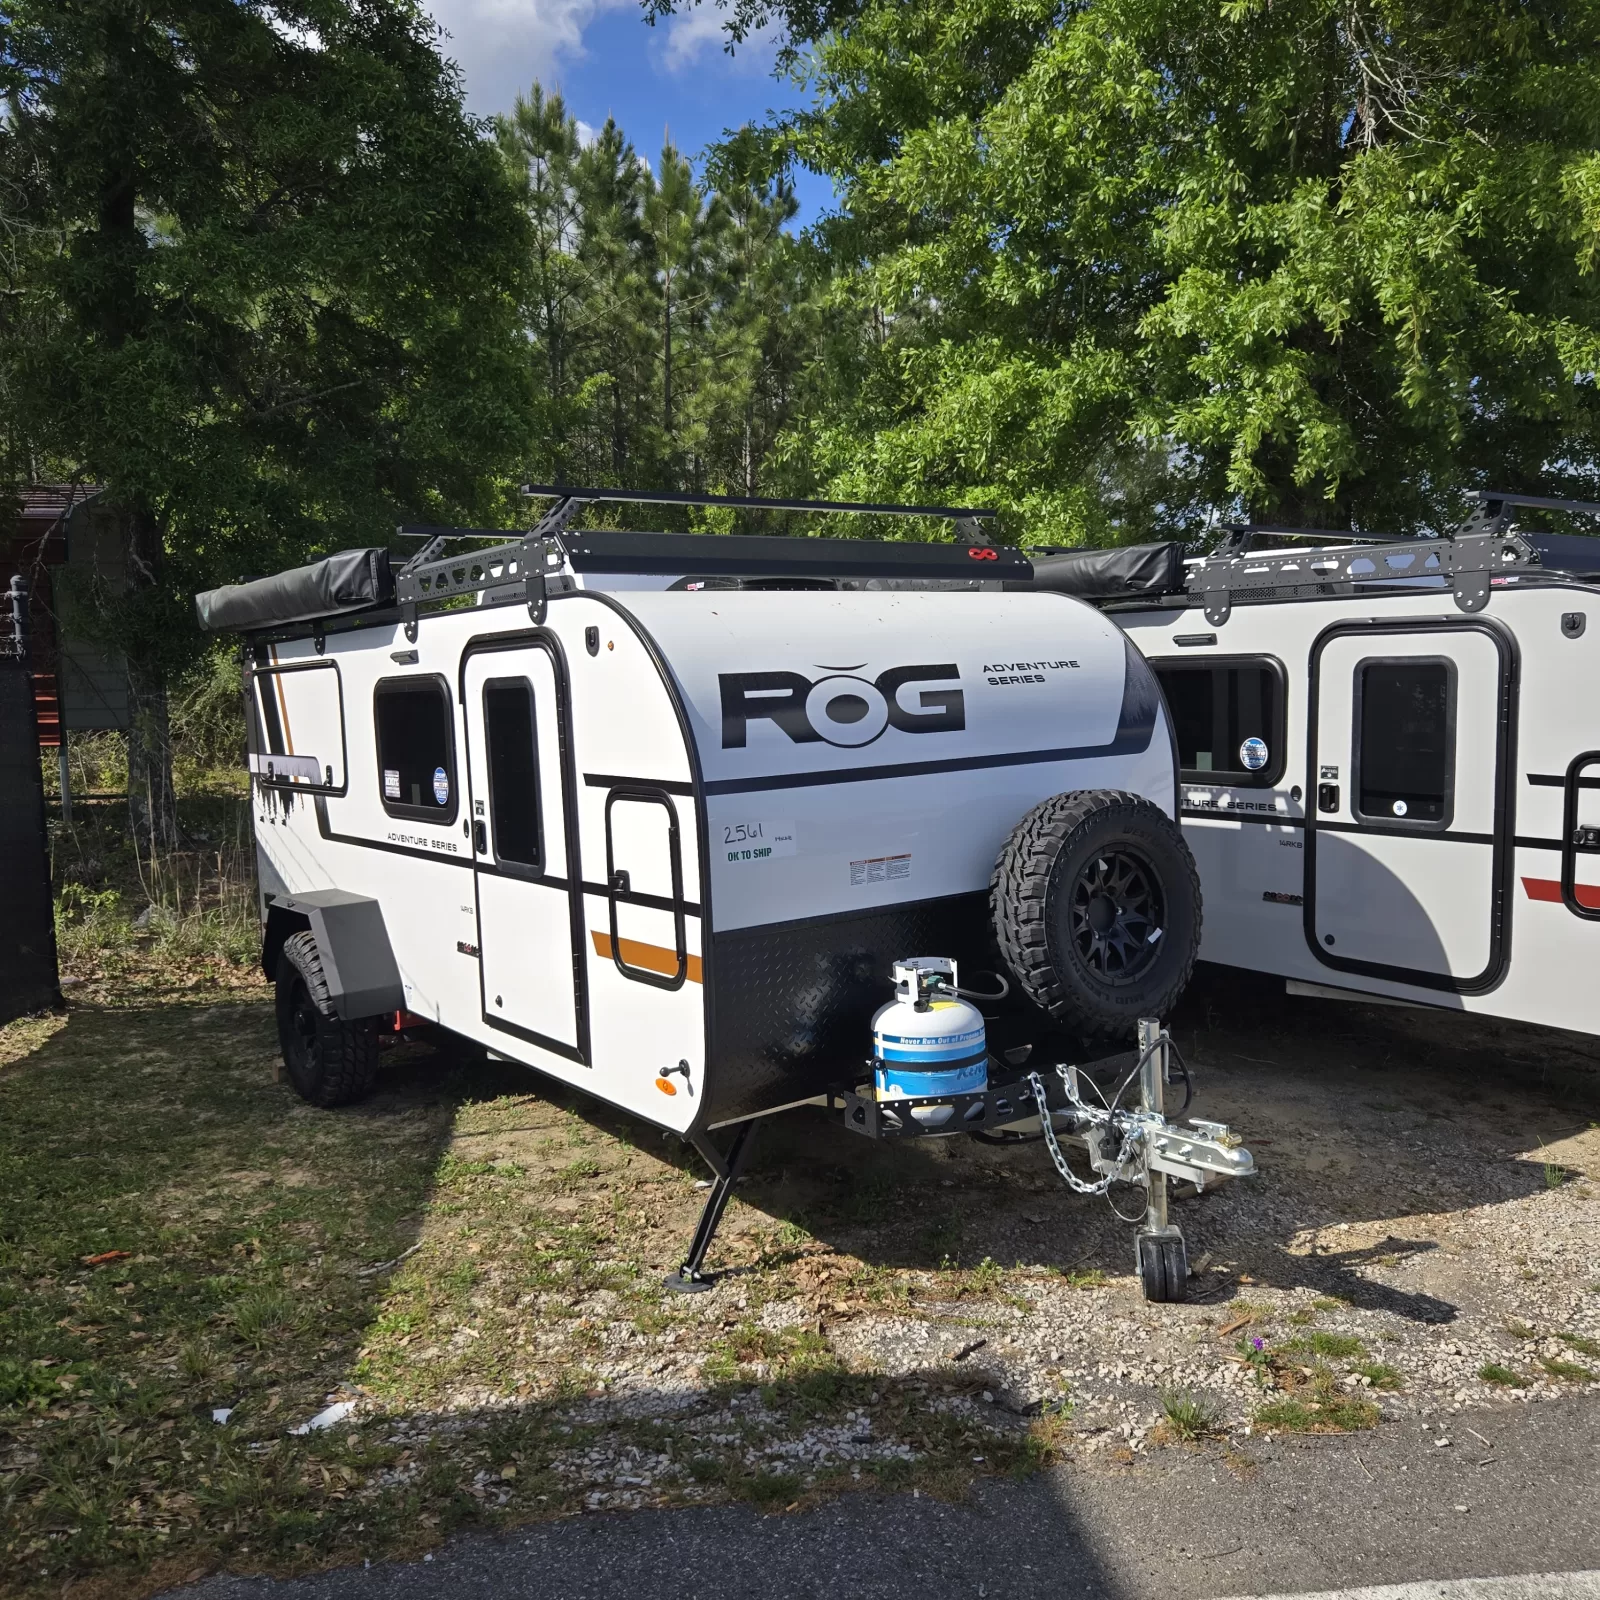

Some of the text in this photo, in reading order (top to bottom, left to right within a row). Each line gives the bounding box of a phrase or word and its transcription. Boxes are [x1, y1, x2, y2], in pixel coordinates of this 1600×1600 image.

[983, 660, 1080, 673] ADVENTURE
[987, 674, 1046, 686] SERIES
[1226, 801, 1277, 811] SERIES
[724, 823, 764, 844] 2561
[387, 832, 457, 852] ADVENTURE SERIES
[1279, 840, 1303, 849] 14RKB
[727, 847, 772, 862] OK TO SHIP
[900, 1037, 920, 1045] Never
[922, 1037, 936, 1045] Run
